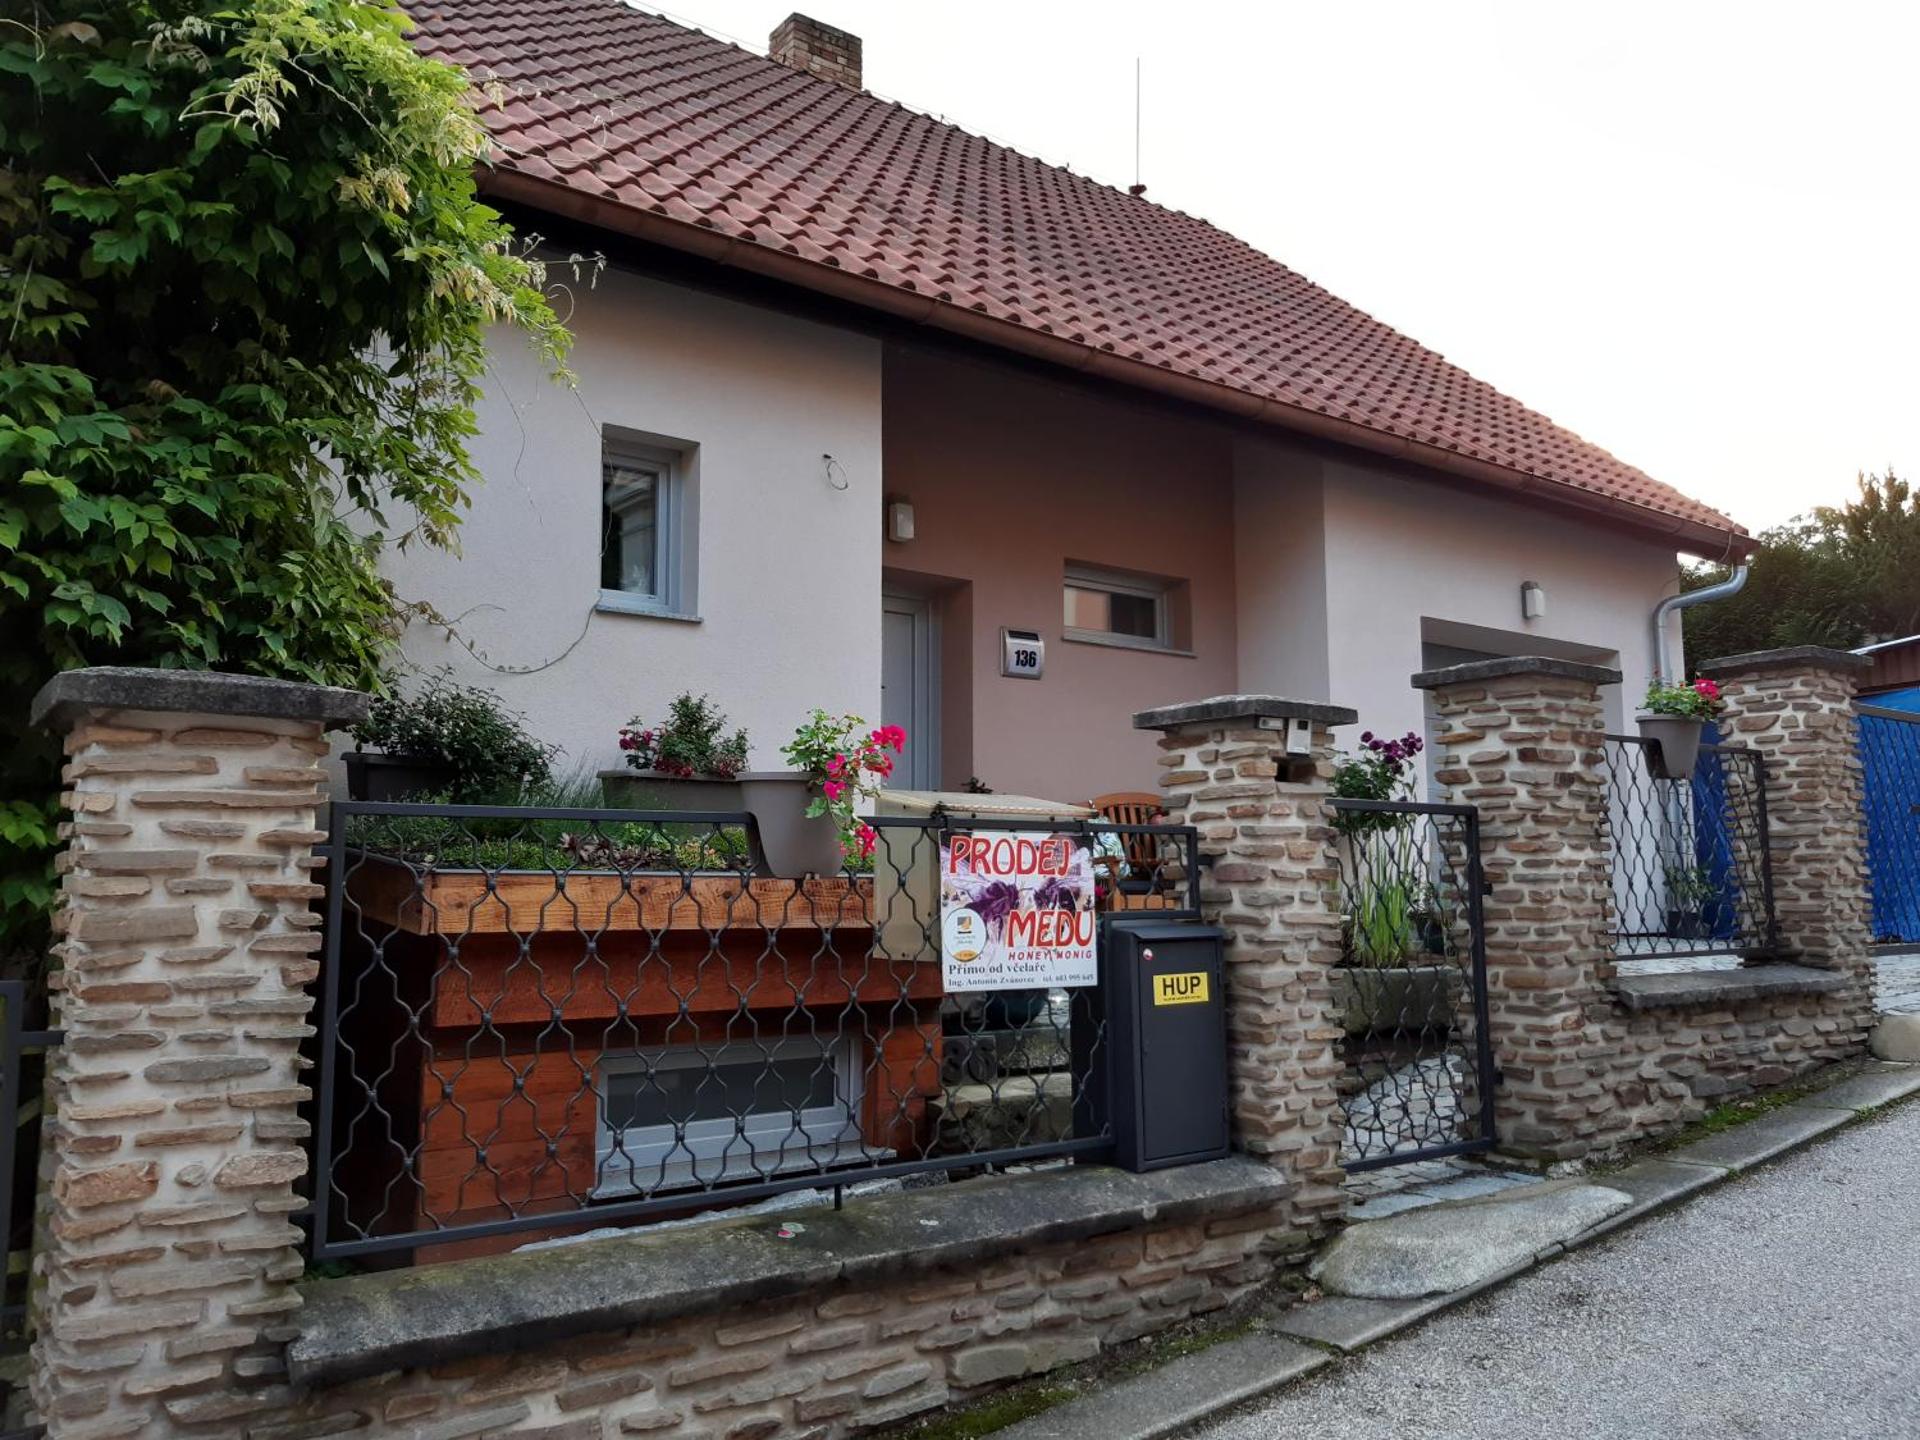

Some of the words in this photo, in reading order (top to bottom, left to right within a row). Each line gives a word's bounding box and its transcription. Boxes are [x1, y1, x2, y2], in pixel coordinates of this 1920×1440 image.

[1014, 650, 1037, 668] 136
[949, 836, 1071, 877] PRODEJ
[1007, 910, 1094, 948] MEDU
[1008, 951, 1048, 960] HONEY
[949, 963, 986, 975] Přímo
[989, 963, 1003, 974] od
[1007, 962, 1046, 973] včelaře
[949, 978, 964, 987] Ing.
[1162, 975, 1201, 997] HUP
